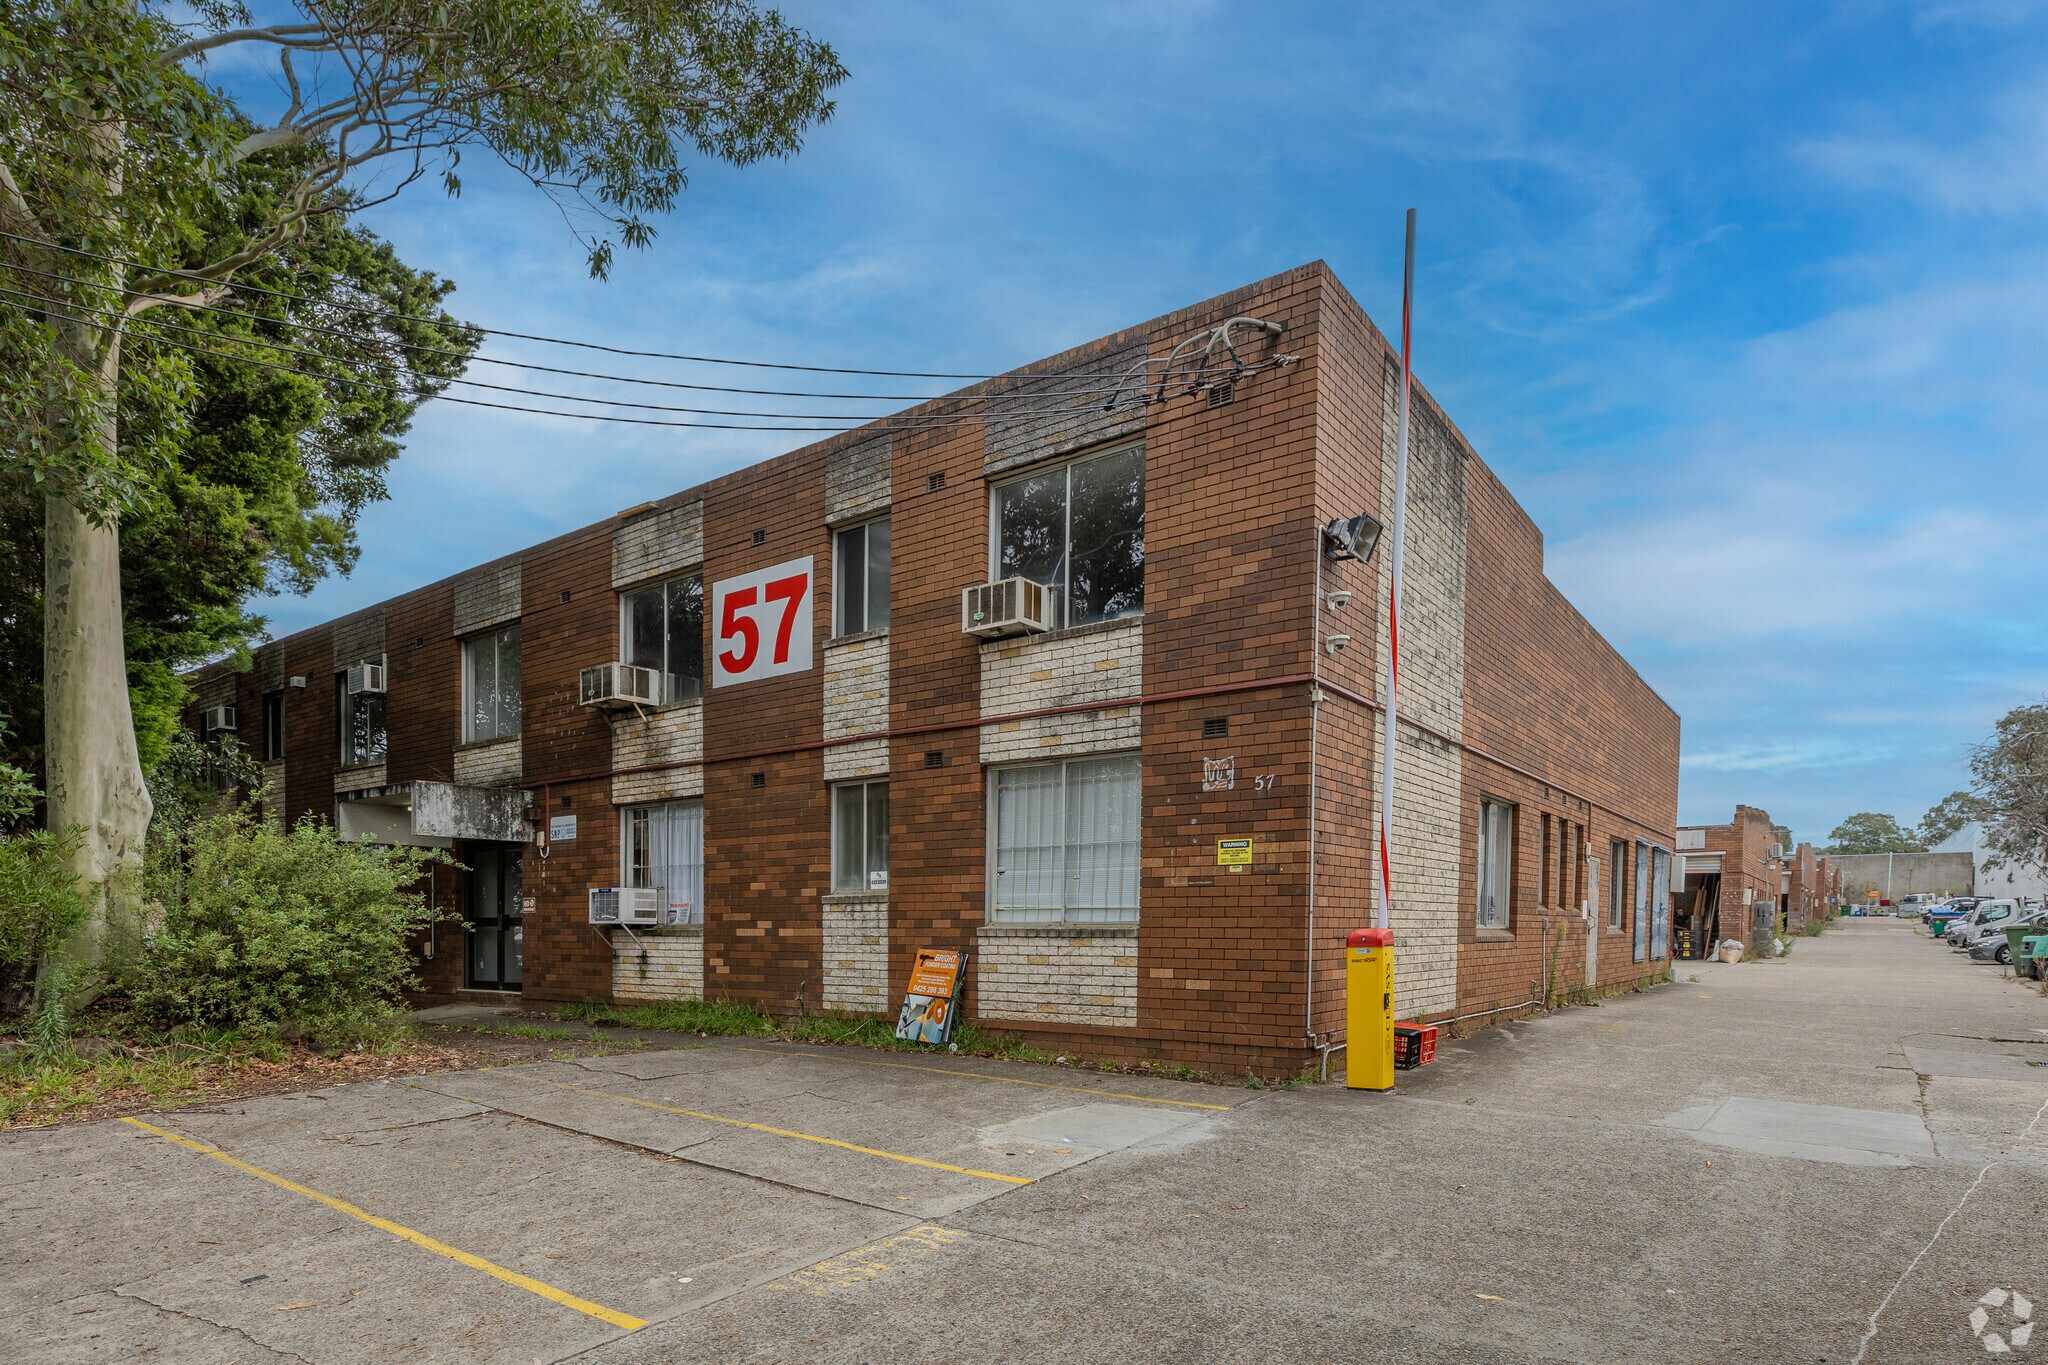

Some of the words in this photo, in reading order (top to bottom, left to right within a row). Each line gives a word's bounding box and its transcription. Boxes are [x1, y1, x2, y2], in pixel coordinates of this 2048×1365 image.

[718, 573, 808, 674] 57
[1254, 774, 1275, 791] 57
[935, 954, 957, 962] BRIGHT
